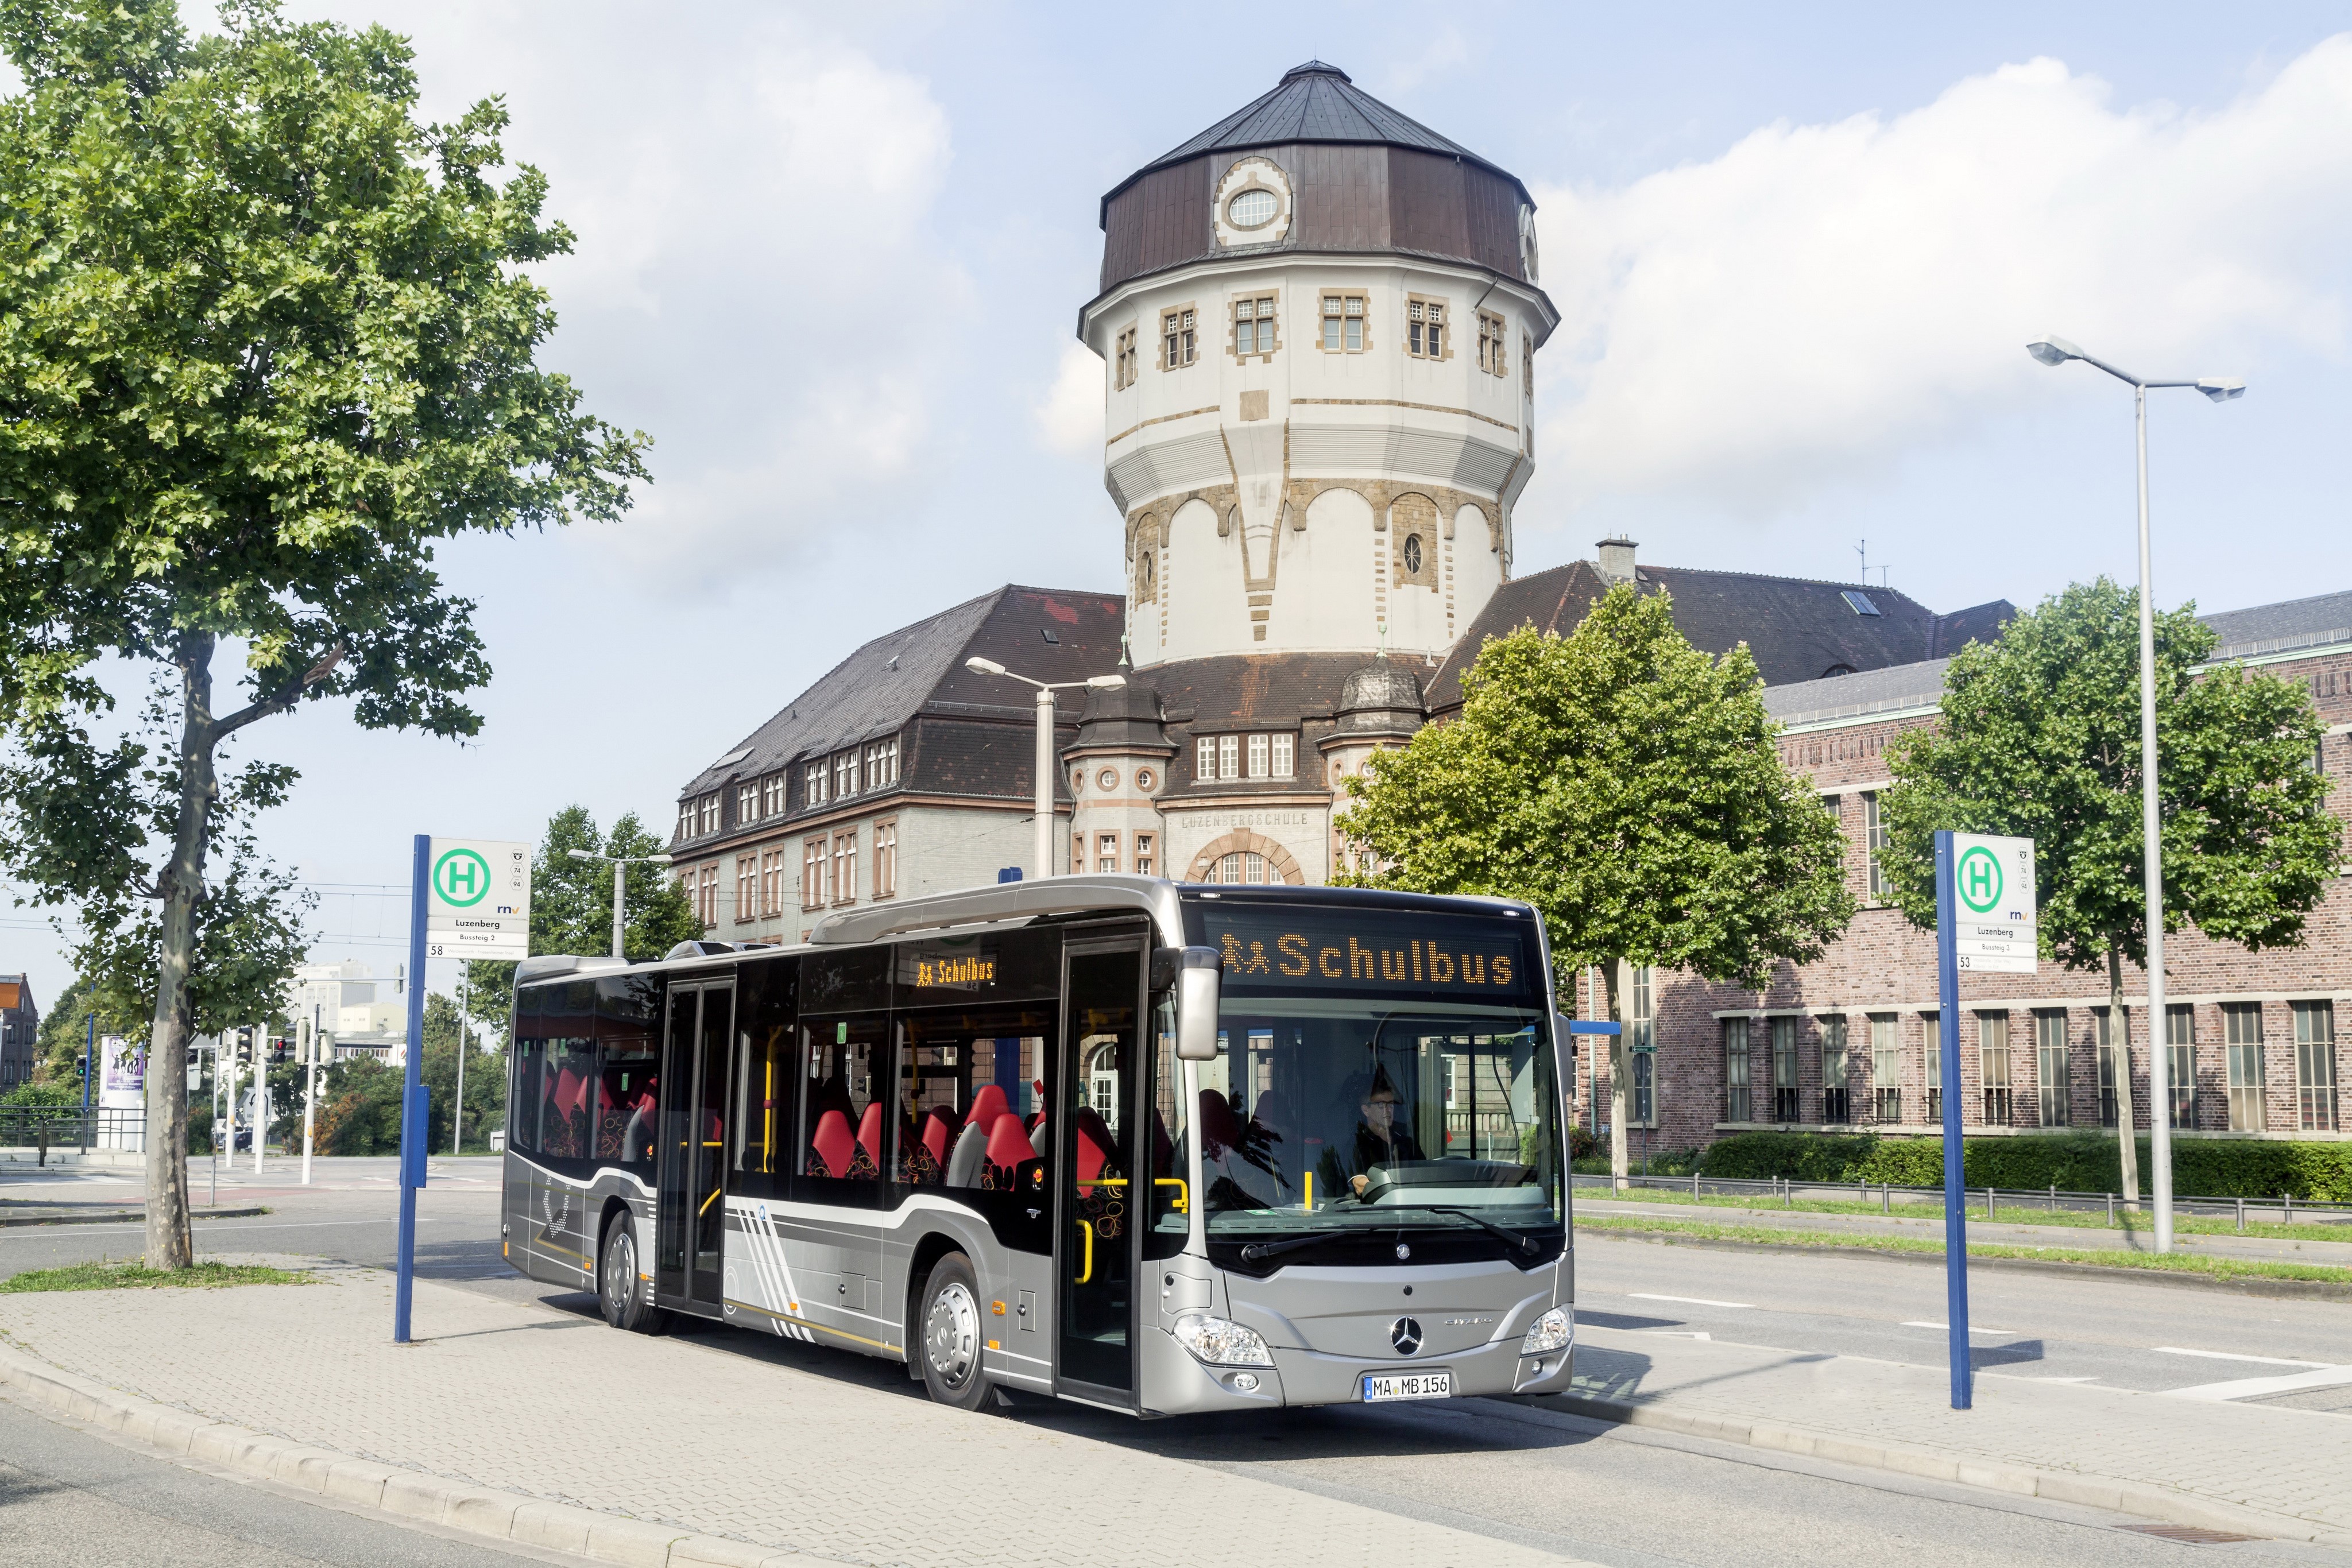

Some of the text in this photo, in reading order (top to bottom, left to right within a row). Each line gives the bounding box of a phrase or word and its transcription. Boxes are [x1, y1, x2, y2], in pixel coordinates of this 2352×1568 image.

[1182, 813, 1307, 828] LUZENBERGSCHULE
[449, 862, 475, 894] H
[1970, 861, 1991, 897] H
[497, 906, 520, 914] rnv
[2010, 911, 2028, 920] rnv
[455, 920, 500, 930] Luzenberg
[1978, 927, 2013, 938] Luzenberg
[431, 946, 443, 955] 58
[1982, 943, 2005, 952] Bussteig
[1278, 934, 1512, 985] Schulbus
[1960, 957, 1970, 967] 53
[939, 957, 993, 983] Schulbus
[1374, 1380, 1391, 1396] MA
[1402, 1379, 1419, 1395] MB
[1423, 1377, 1447, 1393] 156
